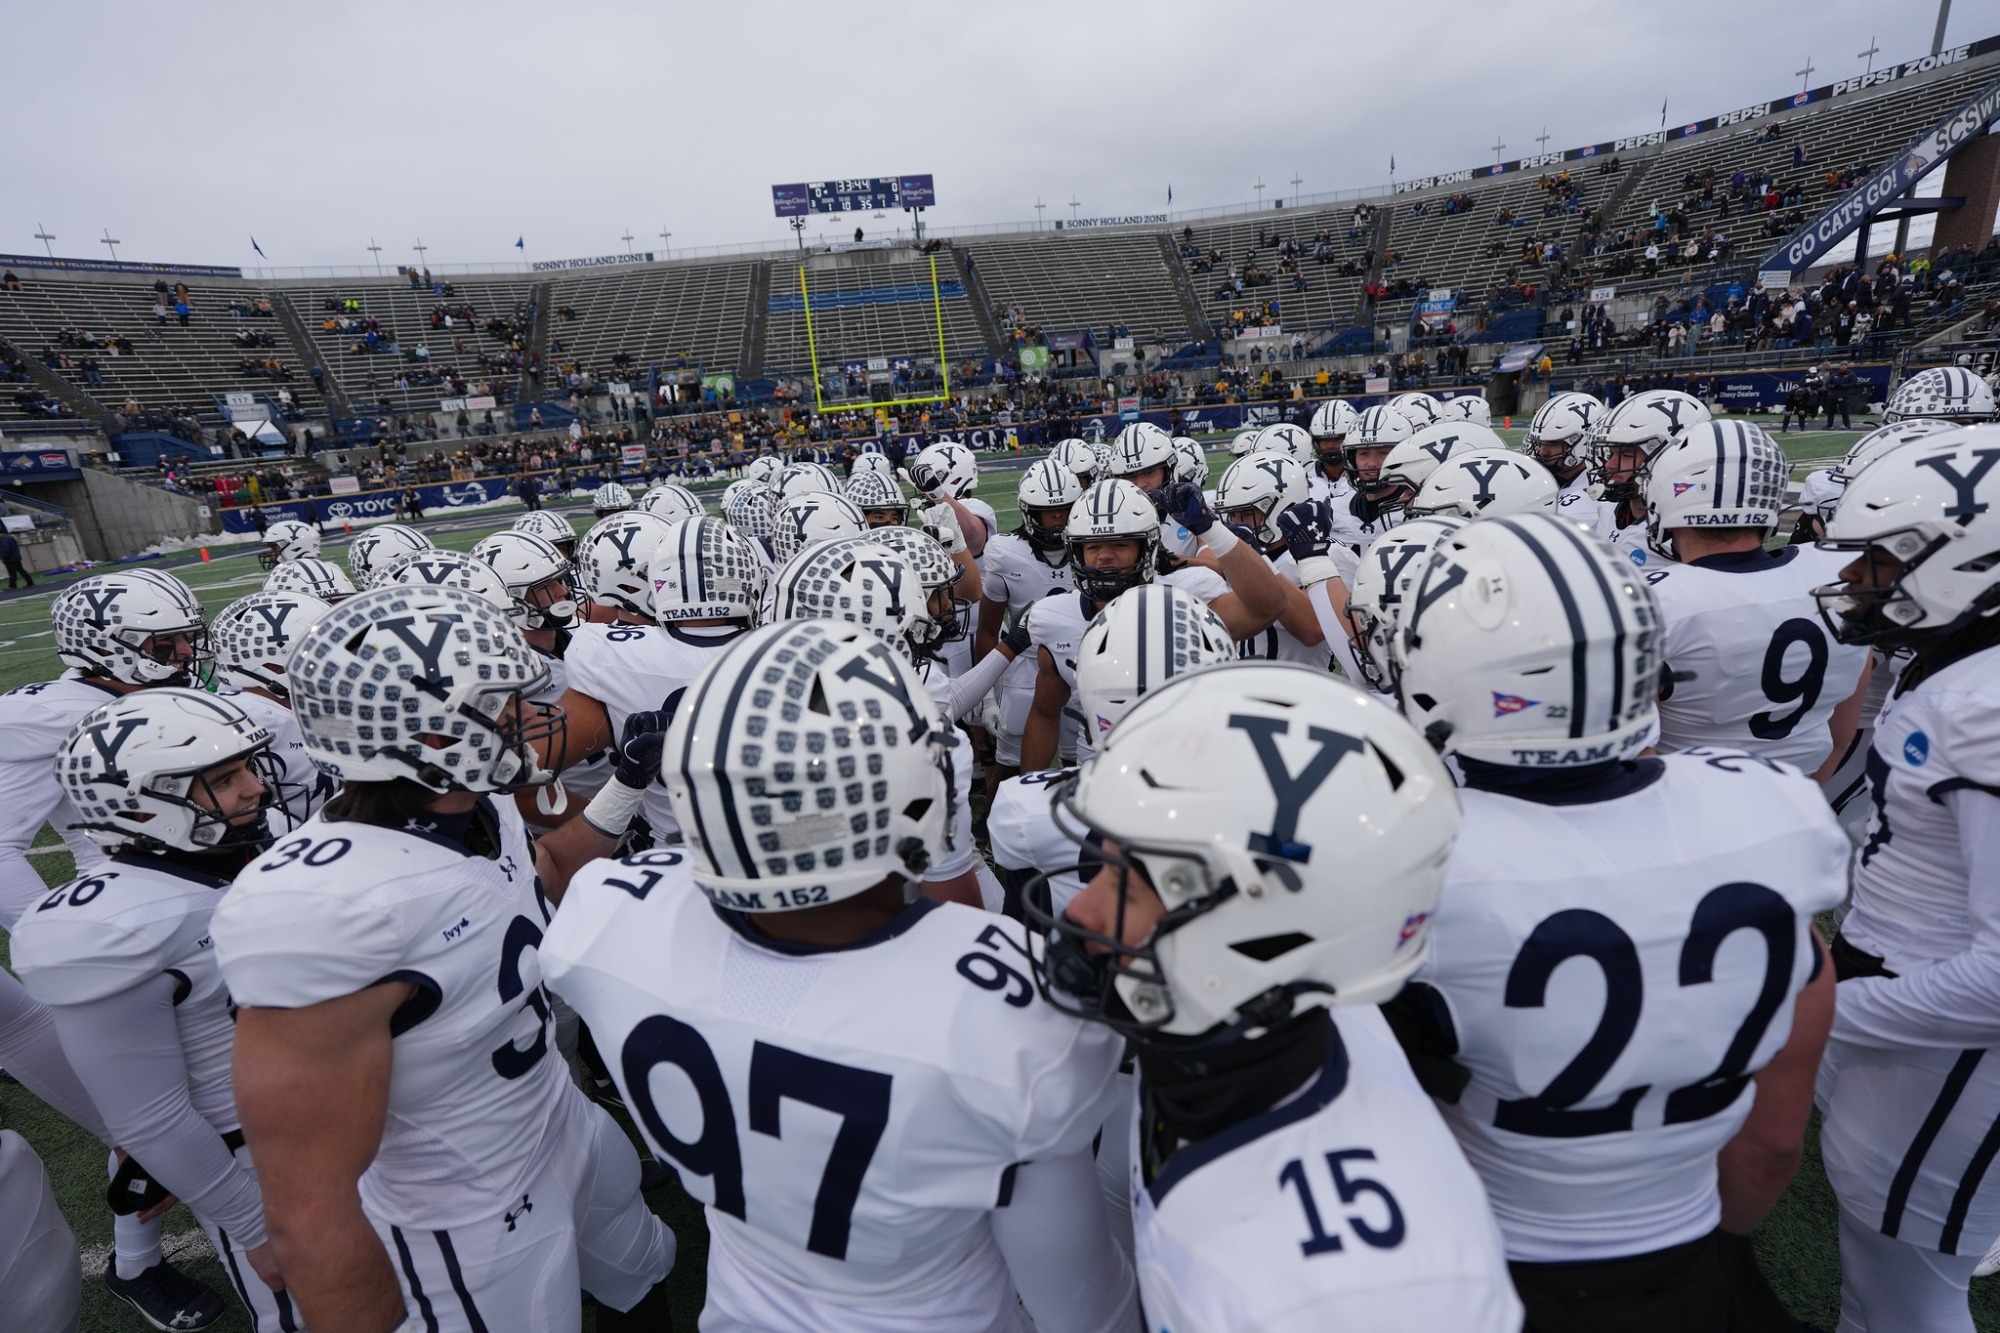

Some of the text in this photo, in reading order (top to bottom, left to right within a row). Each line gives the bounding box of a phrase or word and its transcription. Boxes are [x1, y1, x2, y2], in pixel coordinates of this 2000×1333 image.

[1832, 45, 1970, 97] PEPSI ZONE
[1718, 102, 1771, 128] PEPSI
[1614, 132, 1664, 151] PEPSI
[1520, 152, 1565, 170] PEPSI
[815, 188, 822, 198] 0
[892, 183, 898, 192] 0
[1396, 170, 1474, 194] PEPSI ZONE
[861, 200, 872, 210] 35
[1067, 214, 1167, 228] SONNY HOLLAND ZONE
[1789, 171, 1898, 265] GO CATS GO!
[16, 259, 53, 267] BROKERS
[66, 262, 153, 272] YELLOWSTONE BROKERS
[165, 266, 211, 274] YELLOWSTONE
[532, 253, 644, 271] SONNY HOLLAND ZONE
[1857, 376, 1871, 385] Your
[1719, 391, 1738, 399] Chevy
[1740, 390, 1760, 398] Dealers
[1411, 398, 1437, 420] Y
[1456, 400, 1474, 417] Y
[1568, 401, 1592, 428] Y
[1647, 398, 1684, 434] Y
[1274, 429, 1297, 450] Y
[866, 457, 883, 470] Y
[935, 447, 955, 469] Y
[1180, 441, 1199, 465] Y
[758, 459, 775, 471] Y
[1126, 461, 1143, 470] YALE
[1256, 460, 1288, 491] Y
[778, 471, 801, 496] Y
[1460, 459, 1509, 501] Y
[1915, 449, 2000, 517] Y
[1048, 497, 1065, 505] YALE
[789, 506, 818, 541] Y
[1091, 526, 1115, 535] YALE
[1684, 513, 1769, 525] TEAM 152
[284, 524, 304, 541] Y
[358, 540, 380, 571] Y
[603, 527, 641, 568] Y
[669, 582, 677, 590] 96
[1376, 545, 1427, 605] Y
[316, 589, 341, 598] YALE
[861, 561, 905, 616] Y
[1409, 552, 1467, 640] Y
[80, 589, 127, 628] Y
[663, 606, 730, 620] TEAM 152
[251, 603, 298, 643] Y
[376, 614, 464, 687] Y
[1747, 617, 1828, 740] 9
[836, 643, 930, 744] Y
[1546, 705, 1568, 719] 22
[86, 718, 148, 778] Y
[1512, 742, 1613, 765] TEAM
[1228, 714, 1365, 864] Y
[260, 837, 353, 873] 30
[775, 885, 829, 908] 152
[442, 924, 462, 942] Ivy
[956, 924, 1045, 1008] 97
[1494, 882, 1798, 1139] 22
[622, 1014, 892, 1261] 97
[1279, 1147, 1403, 1259] 15
